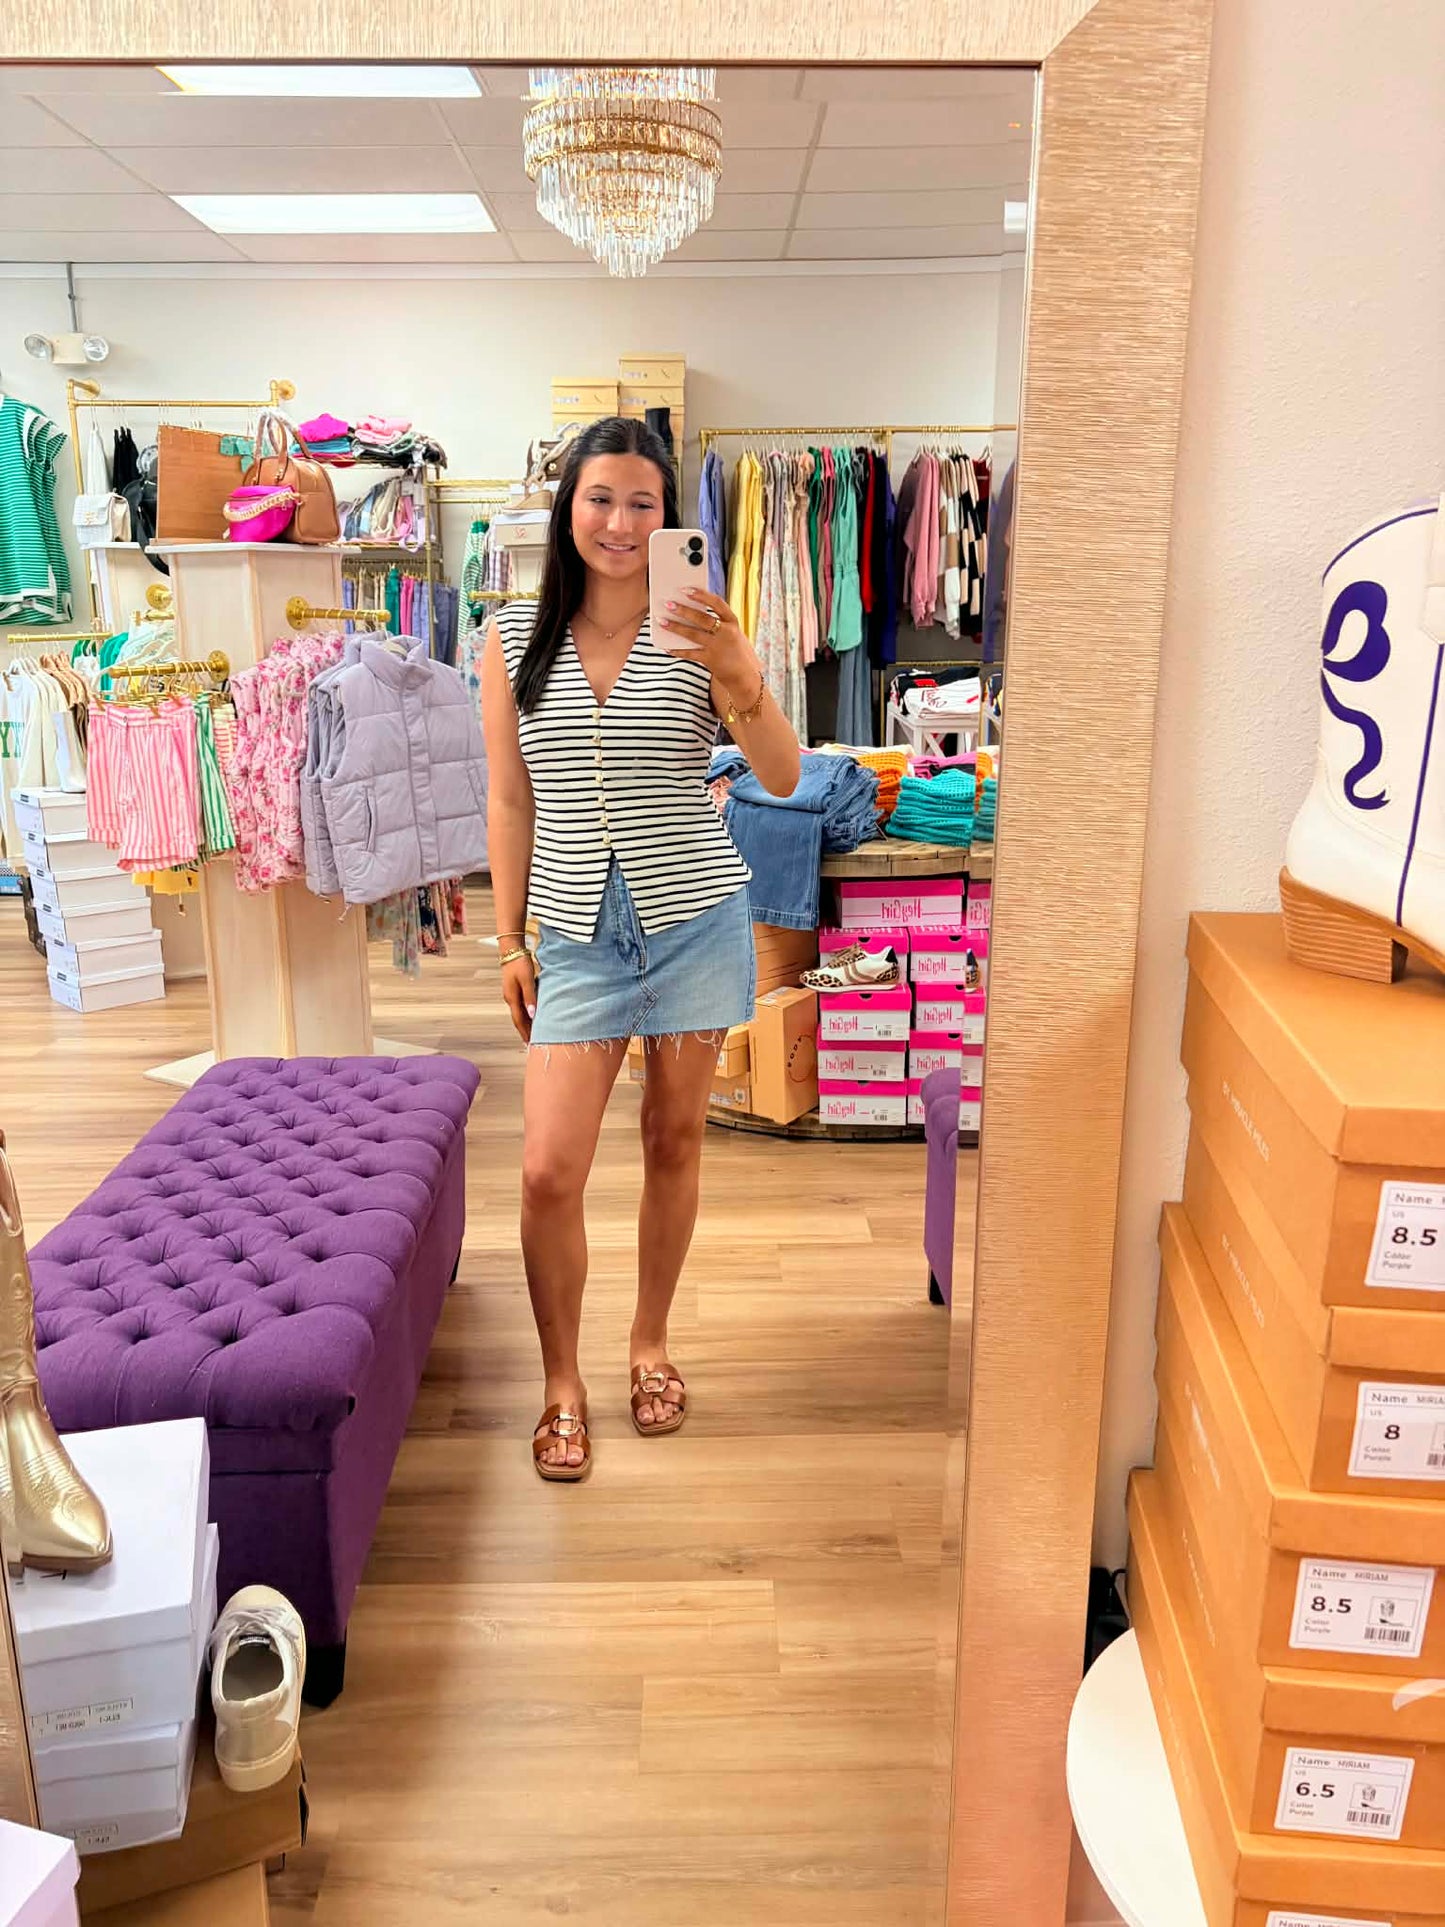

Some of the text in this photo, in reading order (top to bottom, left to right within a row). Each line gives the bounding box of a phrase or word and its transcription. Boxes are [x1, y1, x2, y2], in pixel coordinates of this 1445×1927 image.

[1394, 1193, 1433, 1204] Name
[1391, 1226, 1438, 1246] 8.5
[1371, 1393, 1408, 1404] Name
[1384, 1424, 1401, 1440] 8
[1311, 1568, 1347, 1578] Name
[1310, 1595, 1352, 1614] 8.5
[1297, 1756, 1371, 1769] Name MIRIAM
[1295, 1782, 1336, 1799] 6.5
